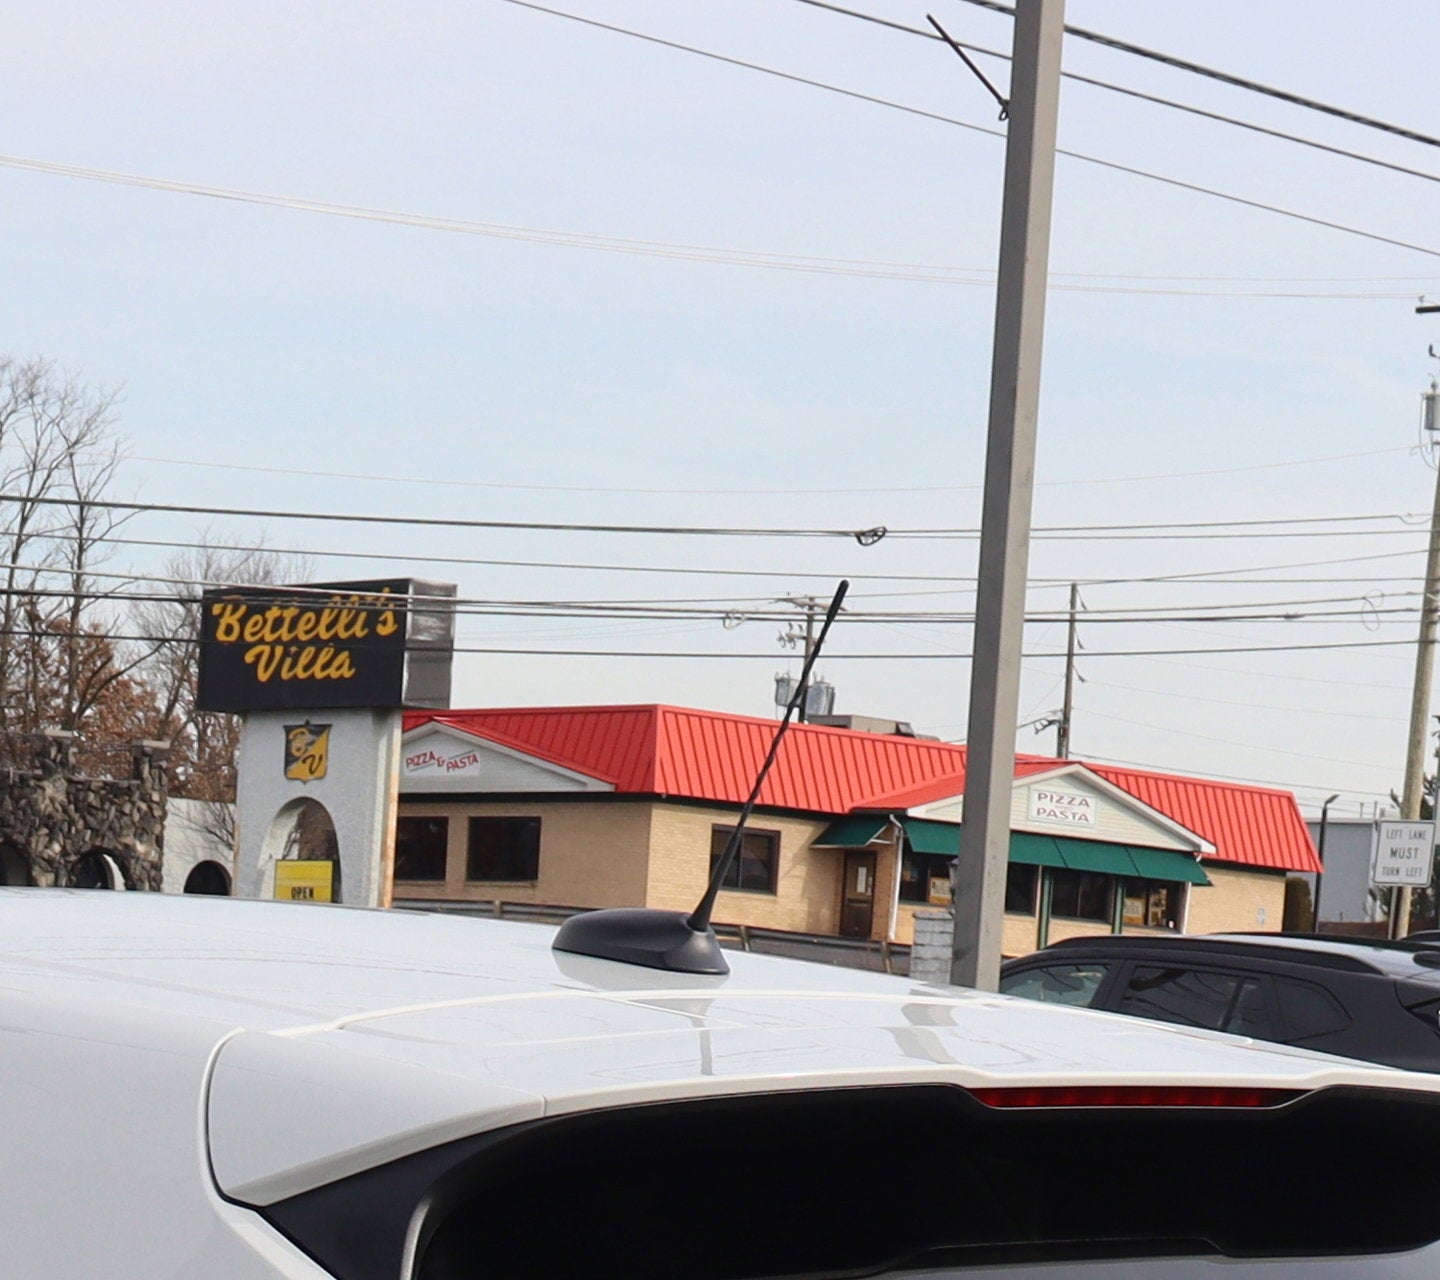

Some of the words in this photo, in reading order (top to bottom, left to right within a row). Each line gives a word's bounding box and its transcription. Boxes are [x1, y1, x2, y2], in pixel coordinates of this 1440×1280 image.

[211, 587, 398, 642] Bettelli's
[244, 643, 356, 683] Villa
[405, 750, 436, 768] PIZZA
[446, 753, 479, 772] PASTA
[1037, 792, 1090, 807] PIZZA
[1036, 807, 1089, 823] PASTA
[1386, 829, 1403, 839] LEFT
[1408, 830, 1427, 840] LANE
[1390, 847, 1420, 859] MUST
[1382, 866, 1400, 876] TURN
[1405, 867, 1423, 877] LEFT
[291, 886, 314, 899] OPEN
